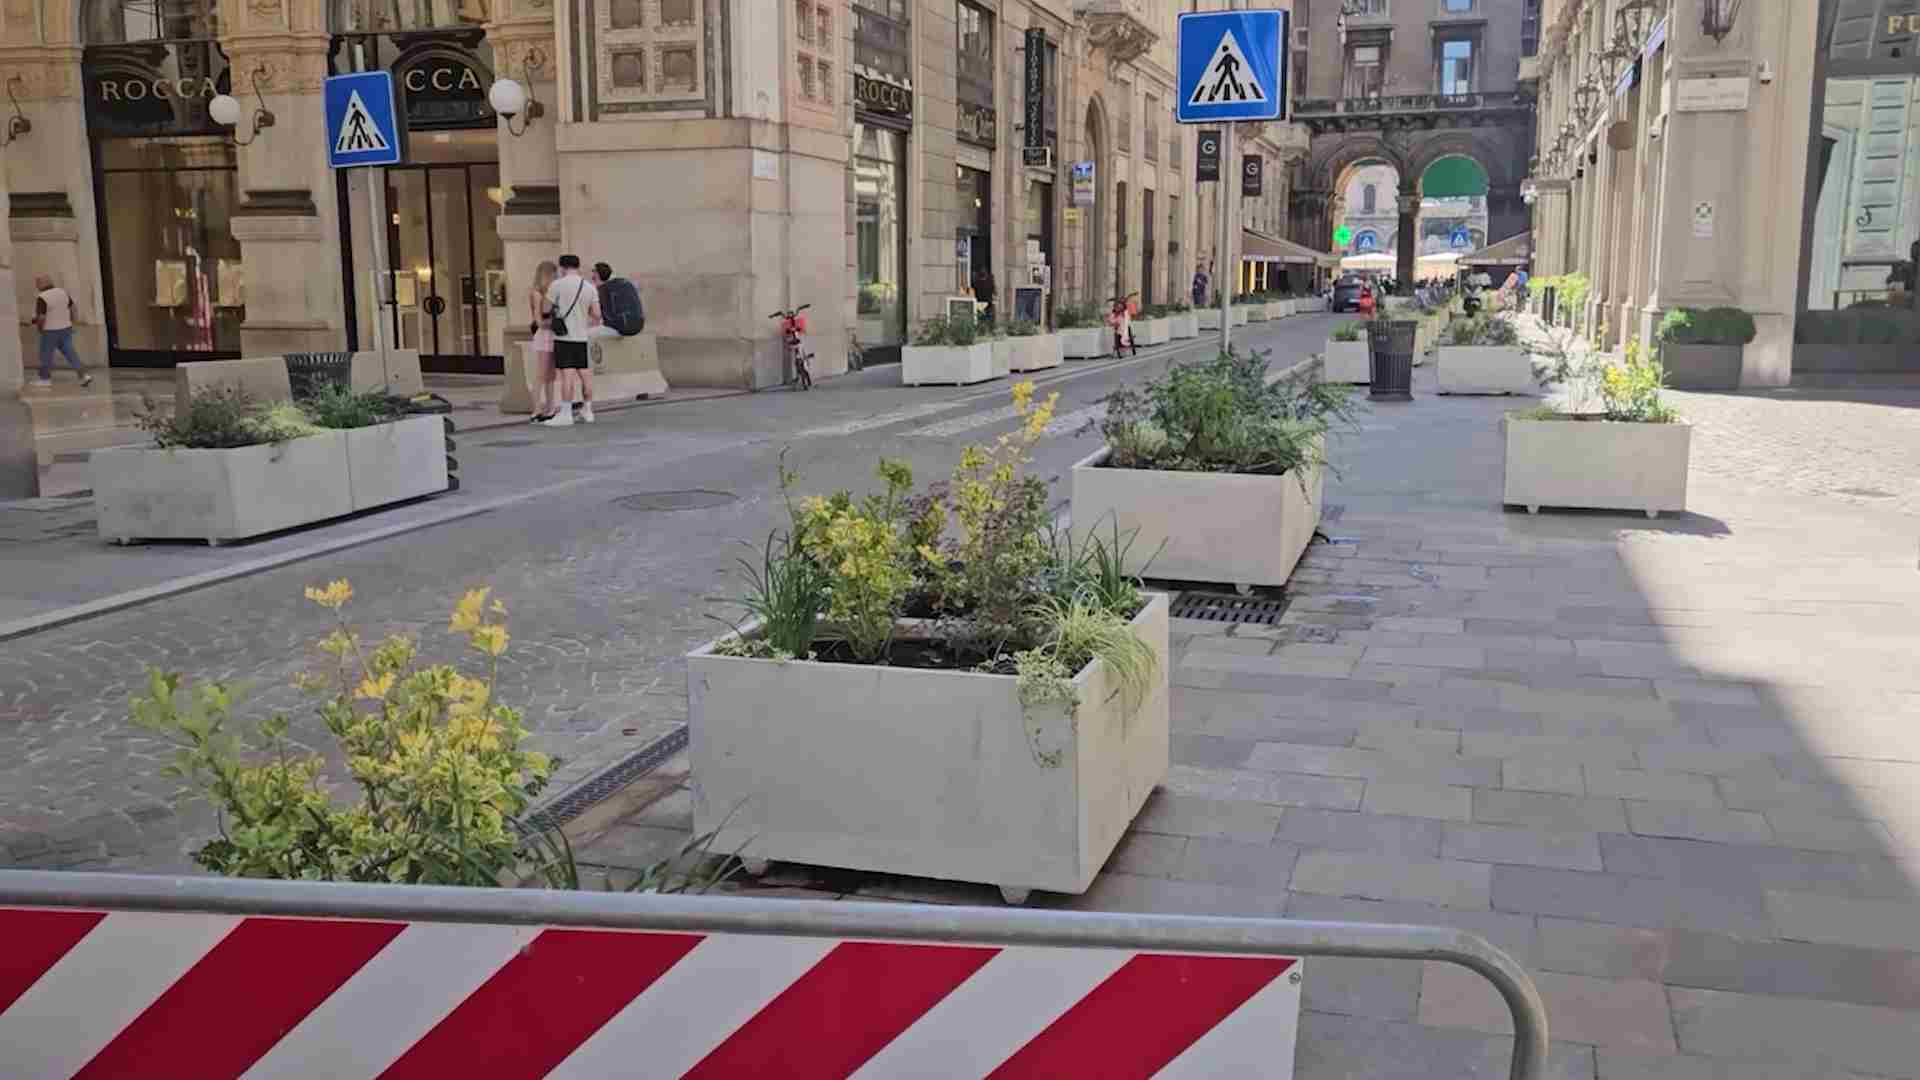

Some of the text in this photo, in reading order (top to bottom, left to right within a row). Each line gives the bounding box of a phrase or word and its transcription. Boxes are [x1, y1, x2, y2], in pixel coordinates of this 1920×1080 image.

[101, 77, 217, 101] ROCCA
[405, 68, 480, 91] CCA
[858, 79, 910, 110] ROCCA
[1202, 140, 1216, 154] G
[1246, 162, 1259, 175] G
